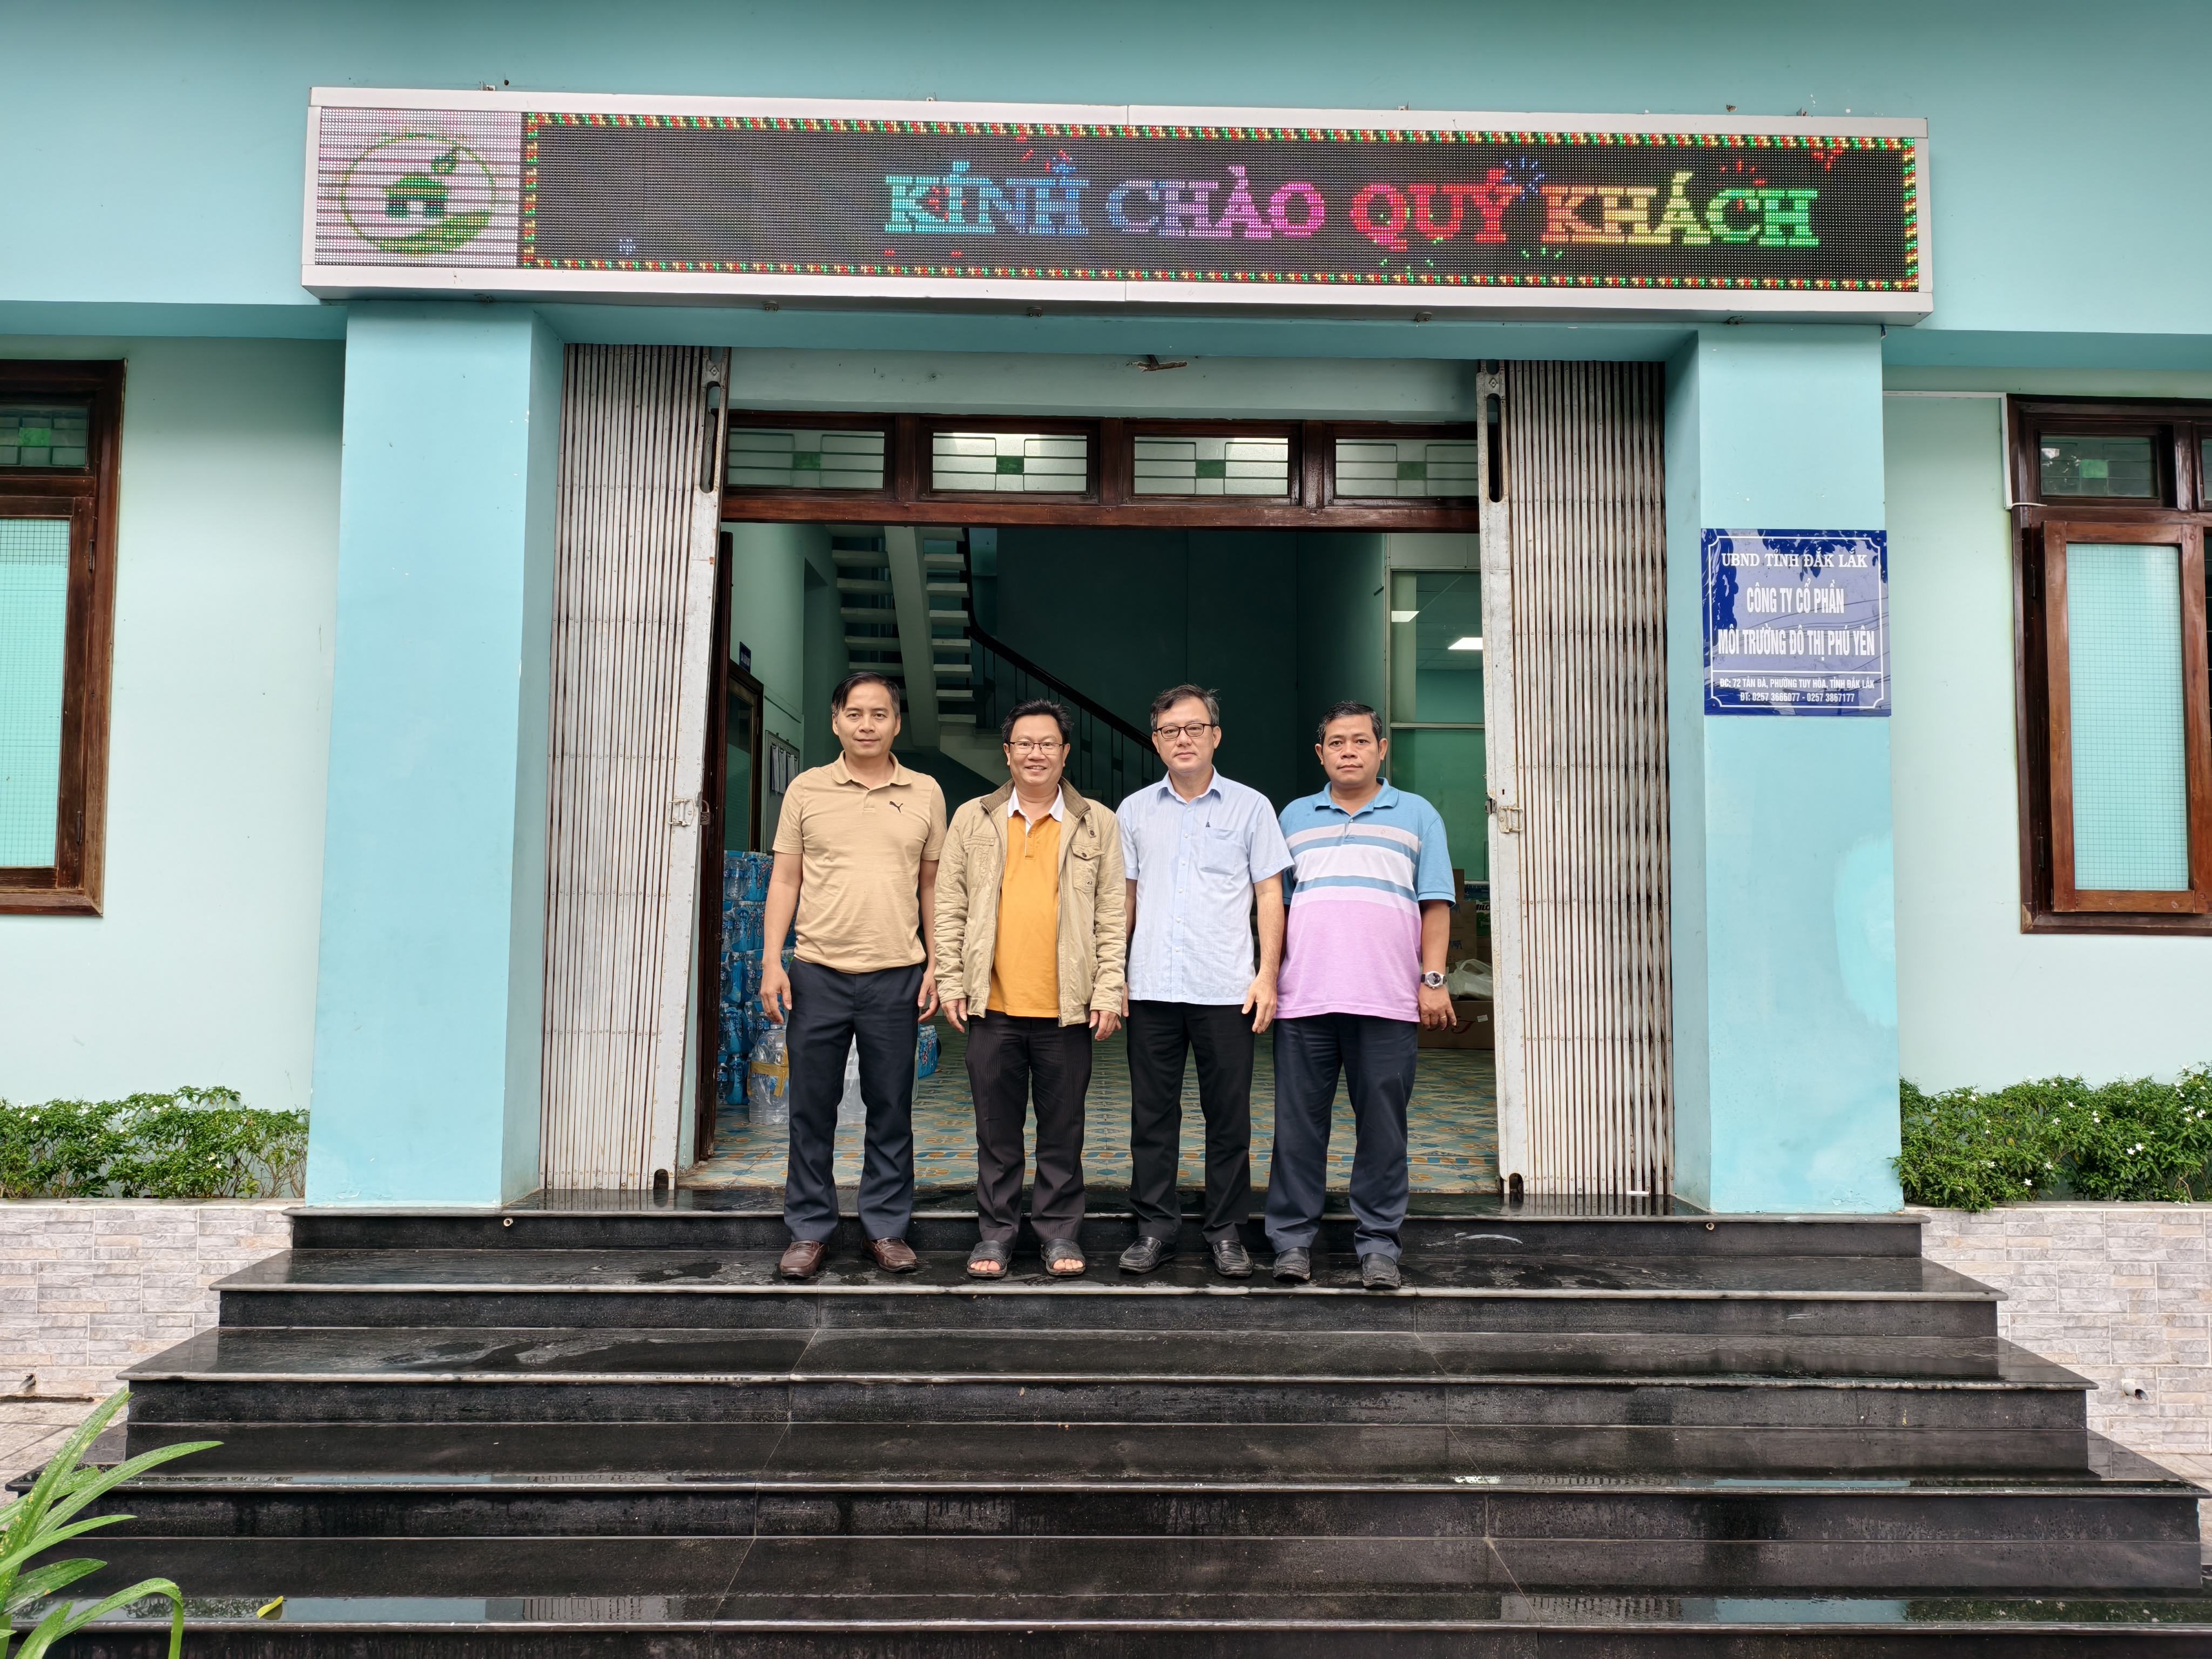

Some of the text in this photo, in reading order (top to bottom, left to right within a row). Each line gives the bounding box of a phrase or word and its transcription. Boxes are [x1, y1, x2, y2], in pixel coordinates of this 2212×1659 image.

[885, 161, 1819, 250] KÍNH CHÀO QUÝ KHÁCH
[1721, 547, 1867, 567] UBND TỈNH ĐẮK LẮK
[1746, 577, 1844, 613] CÔNG TY CỔ PHẦN
[1718, 623, 1875, 661] MÔI TRƯỜNG ĐÔ THỊ PHÚ YÊN
[1719, 676, 1875, 689] ĐC: 72 TẢN ĐÀ, PHƯỜNG TUY HÒA, TỈNH ĐẮK LẮK
[1740, 692, 1750, 701] ĐT:
[1752, 692, 1769, 702] 0257
[1771, 693, 1800, 702] 3666077
[1807, 693, 1823, 702] 0257
[1825, 693, 1854, 702] 3867177
